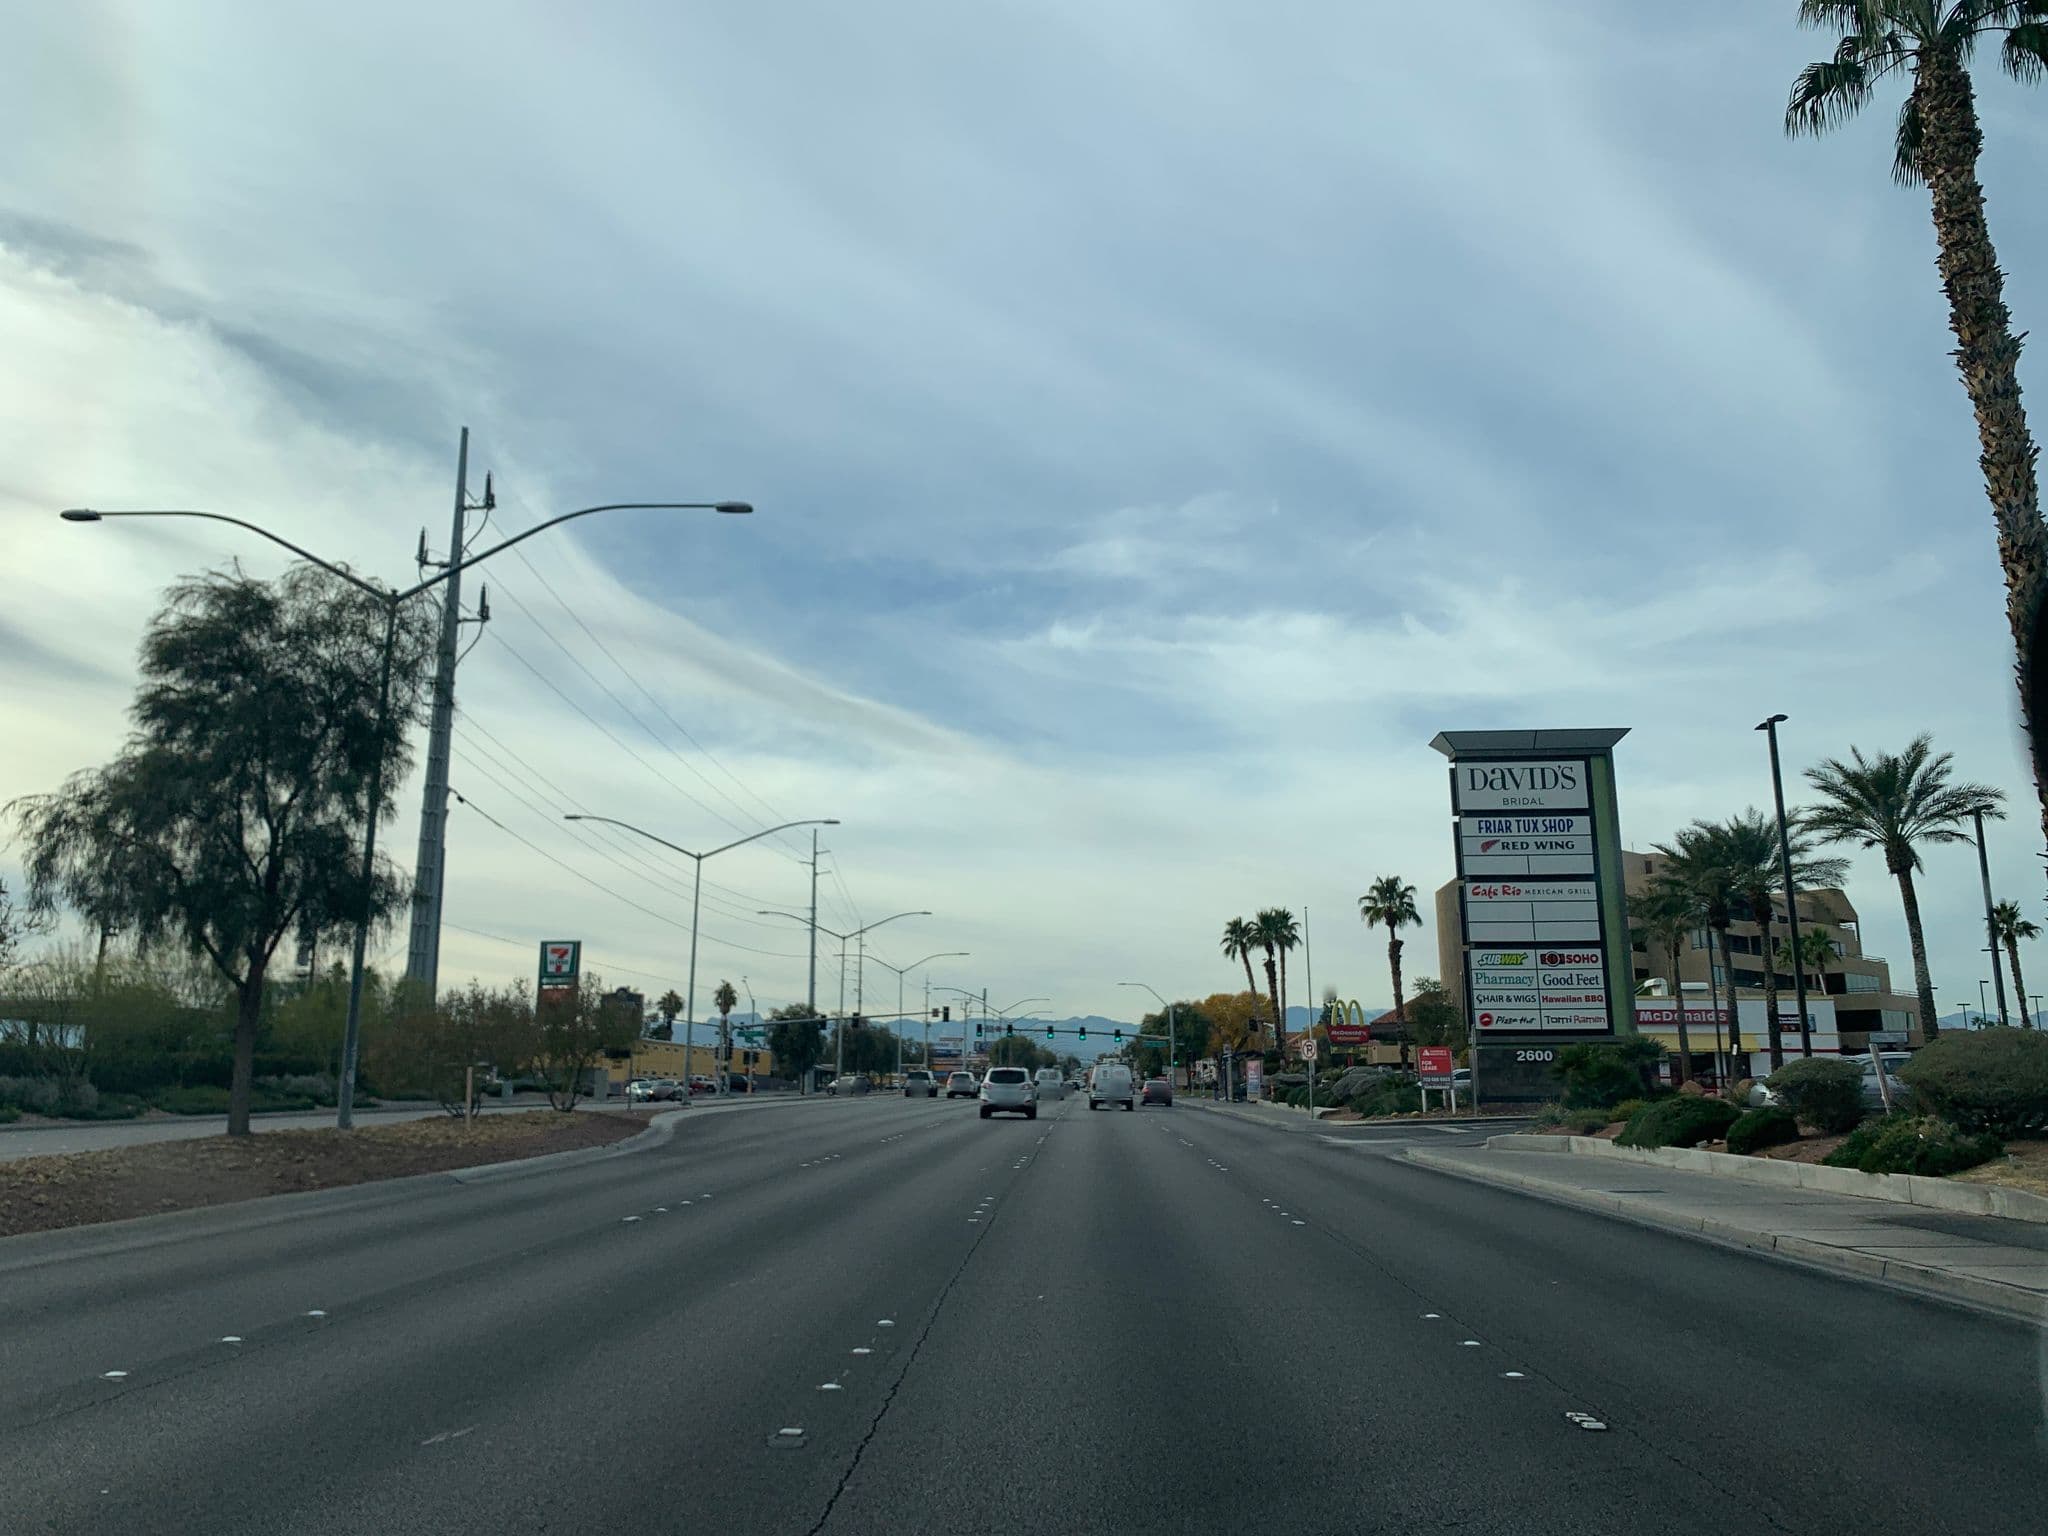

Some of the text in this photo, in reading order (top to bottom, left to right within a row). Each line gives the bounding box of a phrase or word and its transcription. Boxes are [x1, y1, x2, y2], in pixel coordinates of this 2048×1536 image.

[1478, 818, 1574, 834] FRIAR TUX SHOP
[1501, 841, 1575, 850] RED WING
[1502, 884, 1522, 896] Rio
[1478, 952, 1528, 966] SUBWAY
[1566, 954, 1598, 964] SOHO
[1475, 971, 1534, 986] Pharmacy
[1543, 972, 1599, 985] Good Feet
[1506, 995, 1513, 1003] &
[1513, 994, 1537, 1003] WIGS
[1542, 994, 1604, 1003] Hawaiian BBQ
[1544, 1015, 1605, 1024] Tomi Ramen
[1640, 1011, 1727, 1022] McDnalds
[1516, 1050, 1553, 1061] 2600
